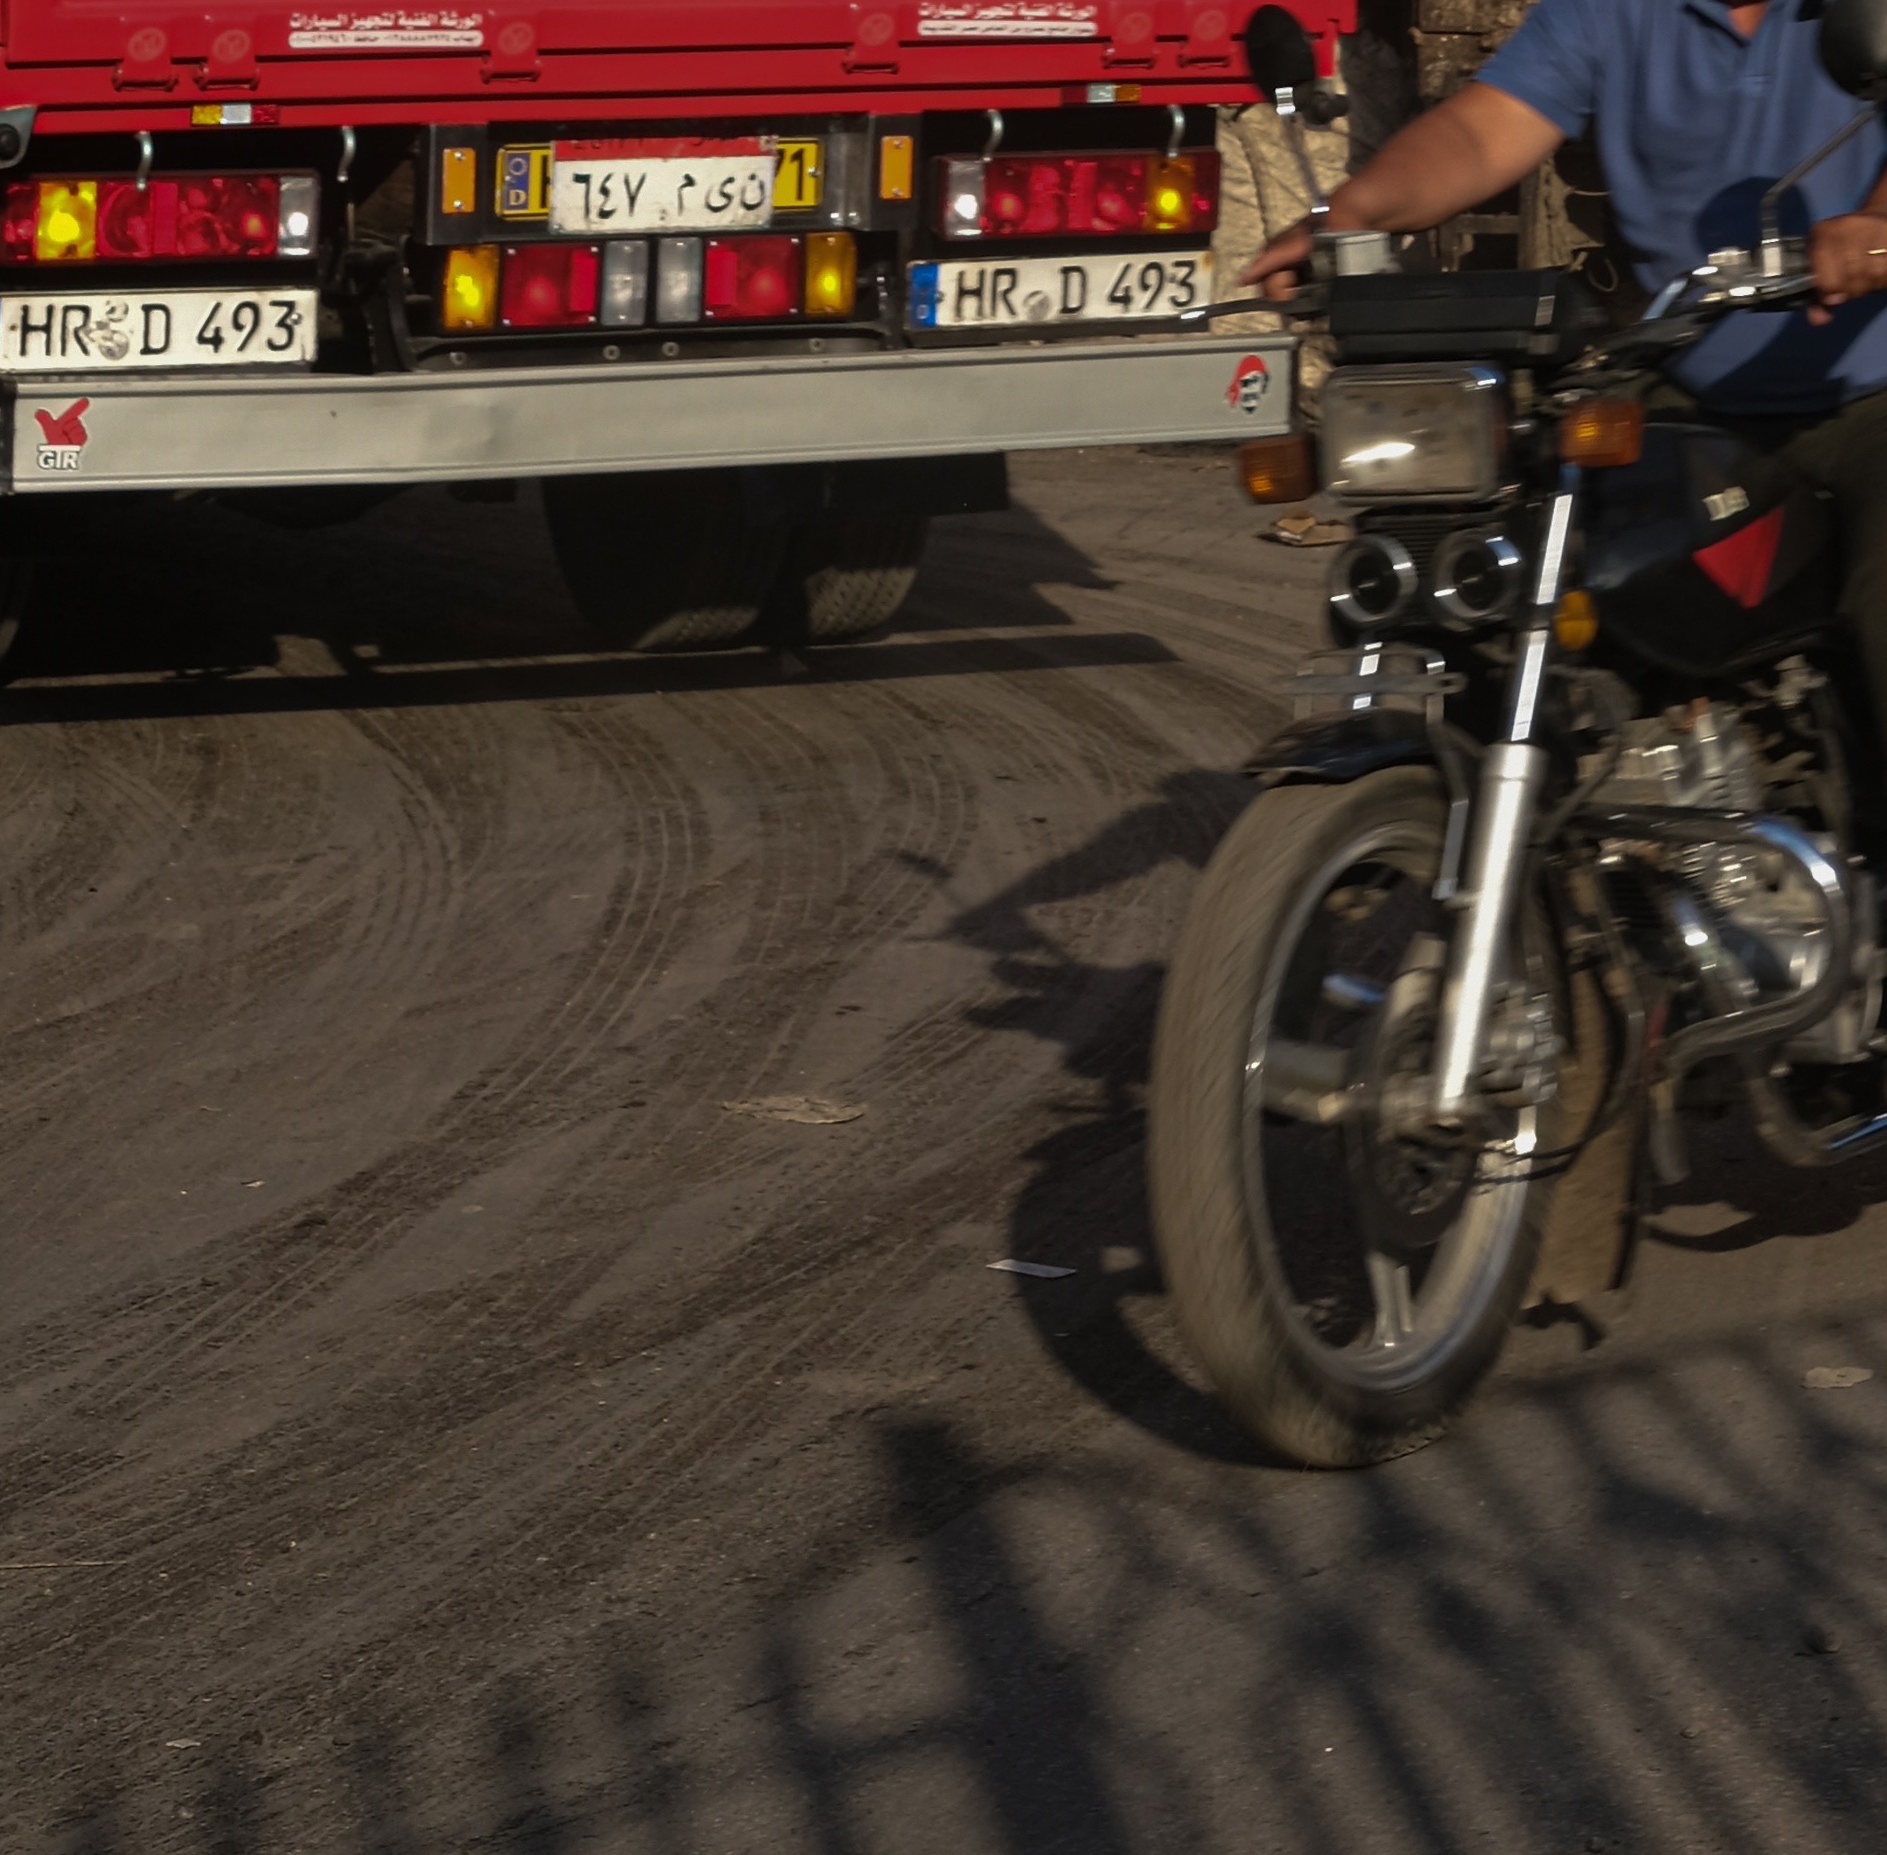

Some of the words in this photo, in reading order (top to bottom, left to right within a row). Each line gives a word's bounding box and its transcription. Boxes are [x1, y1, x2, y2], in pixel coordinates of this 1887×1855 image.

[290, 12, 349, 31] السيارات
[397, 10, 438, 30] الفنية
[440, 10, 483, 30] الورشة
[573, 173, 646, 219] ٦٤٧
[954, 267, 1017, 319] HR
[1059, 265, 1087, 313] D
[1108, 260, 1196, 310] 493
[20, 304, 91, 356] HR
[140, 304, 171, 355] D
[196, 300, 297, 352] 493
[37, 443, 80, 470] GTR
